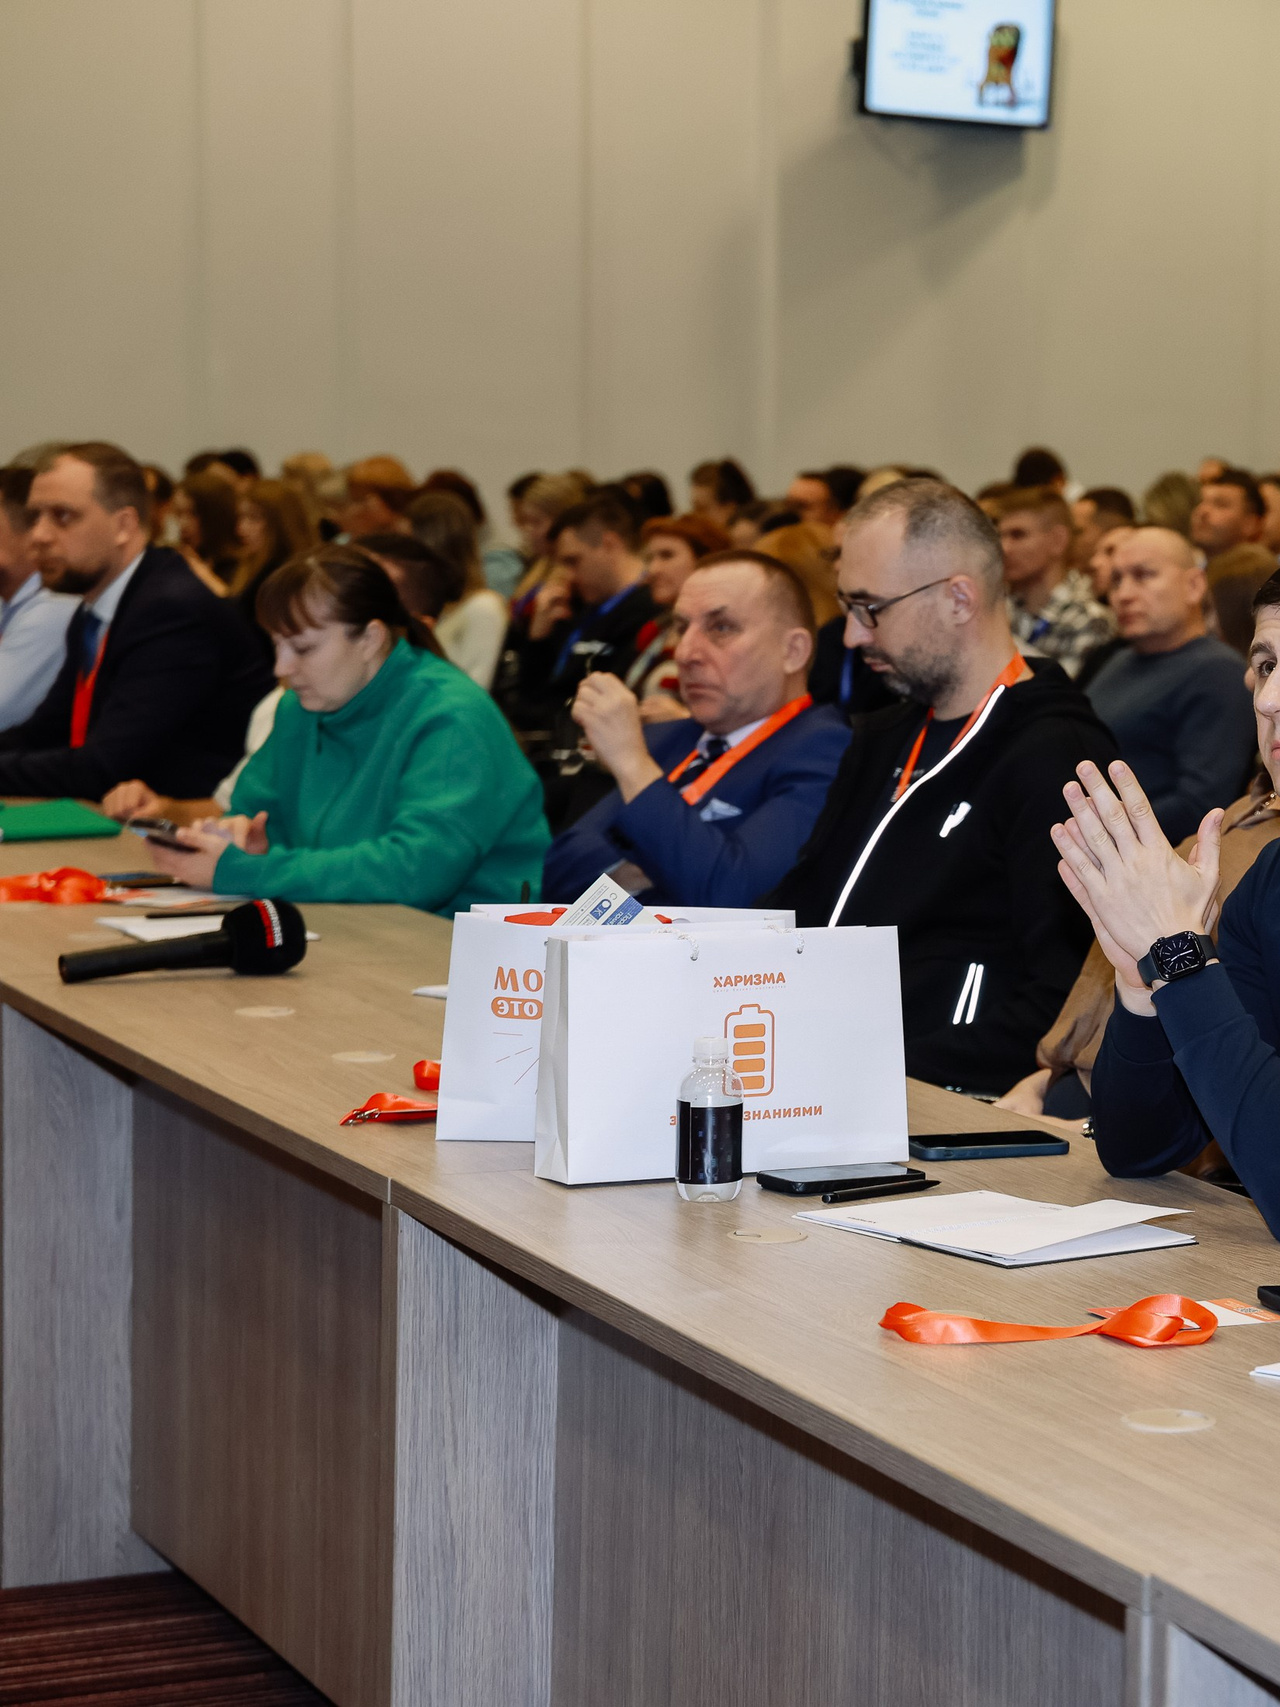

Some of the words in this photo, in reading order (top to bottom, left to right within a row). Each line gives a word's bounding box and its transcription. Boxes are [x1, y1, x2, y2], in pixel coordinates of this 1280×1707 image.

[494, 966, 545, 992] МО
[713, 971, 786, 988] ХАРИЗМА
[497, 999, 538, 1018] ЭТО
[743, 1105, 823, 1121] ЗНАНИЯМИ
